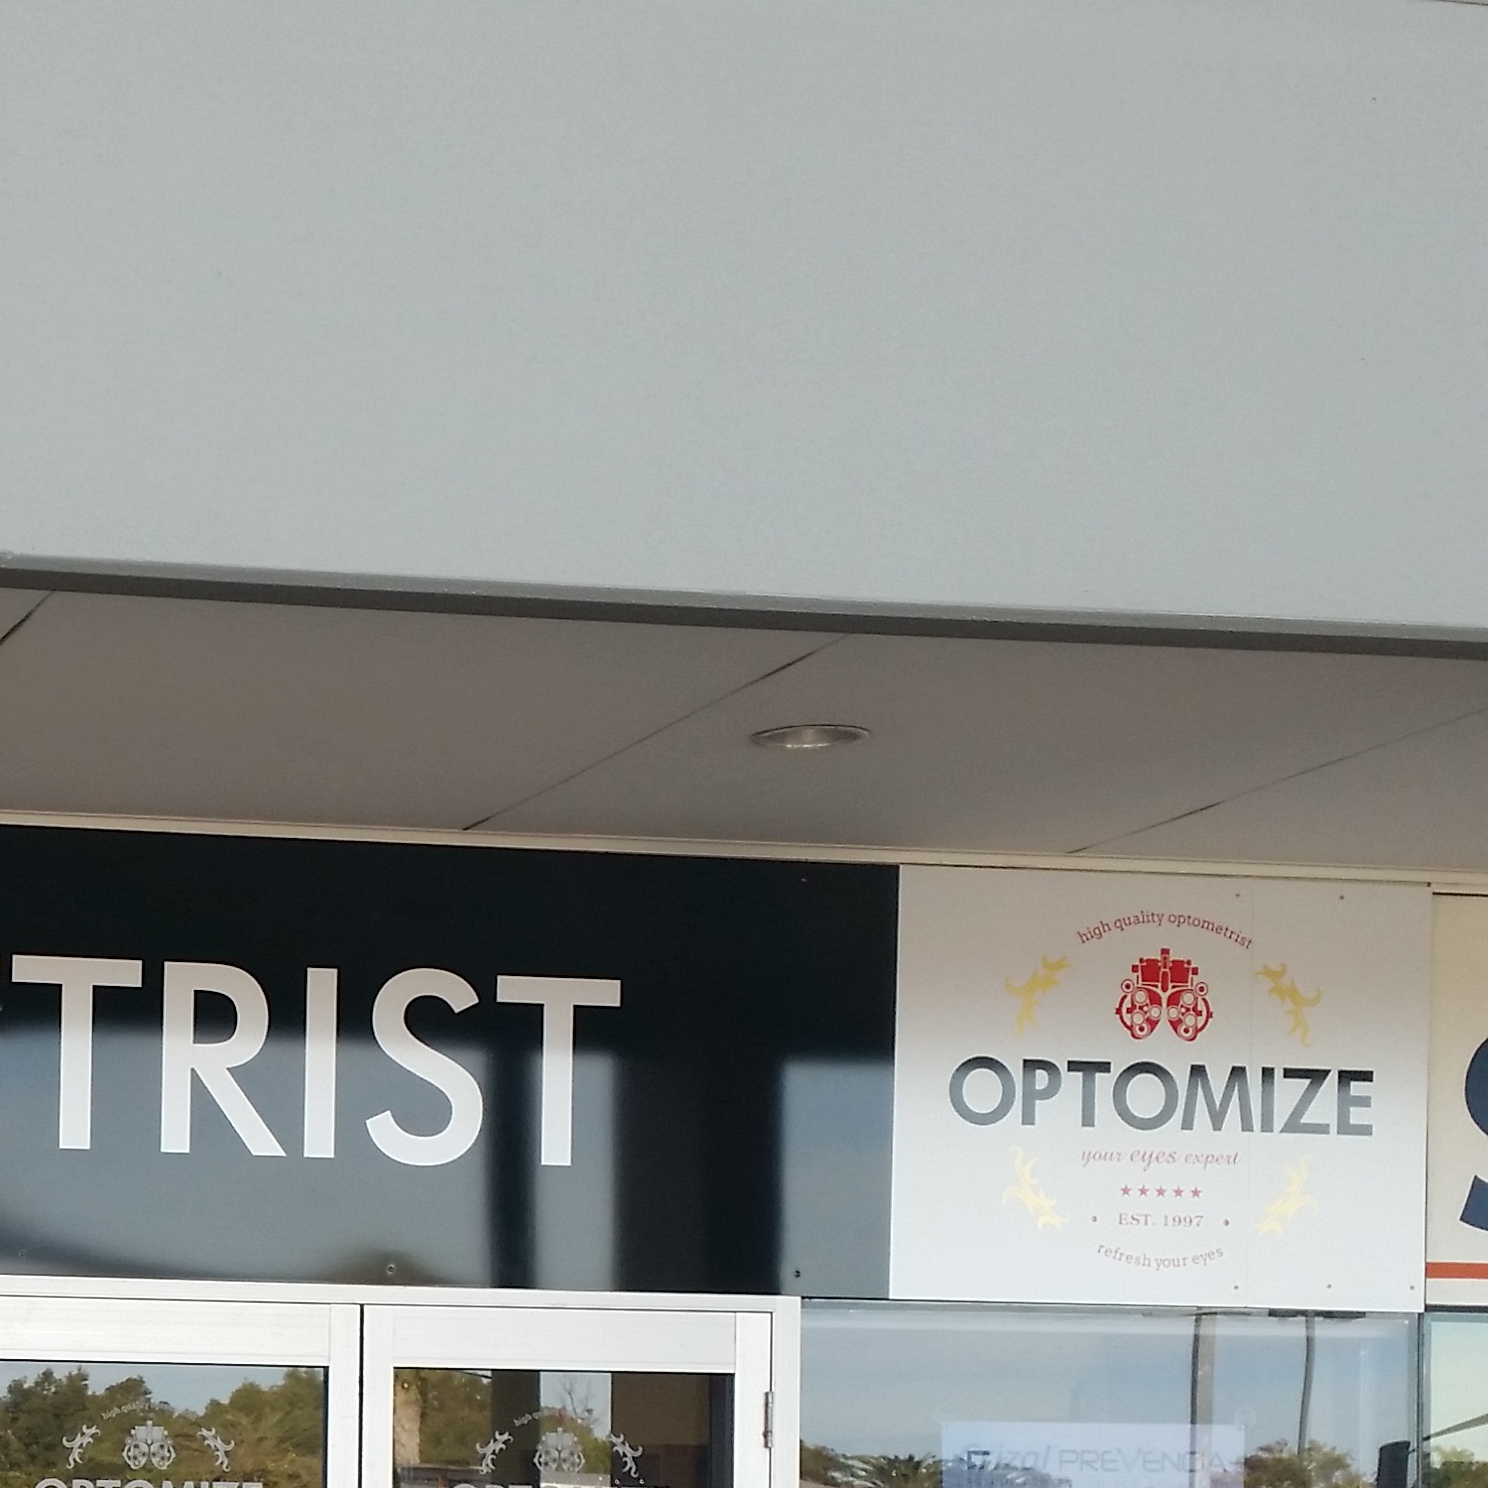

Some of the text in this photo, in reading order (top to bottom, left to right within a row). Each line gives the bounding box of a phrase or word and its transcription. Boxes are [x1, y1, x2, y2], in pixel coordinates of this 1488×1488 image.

[1077, 910, 1254, 950] high quality optometrist
[948, 1055, 1374, 1136] OPTOMIZE
[1081, 1149, 1241, 1172] your eyes expert
[1118, 1213, 1204, 1228] EST. 1997
[1096, 1243, 1224, 1271] refresh your eyes
